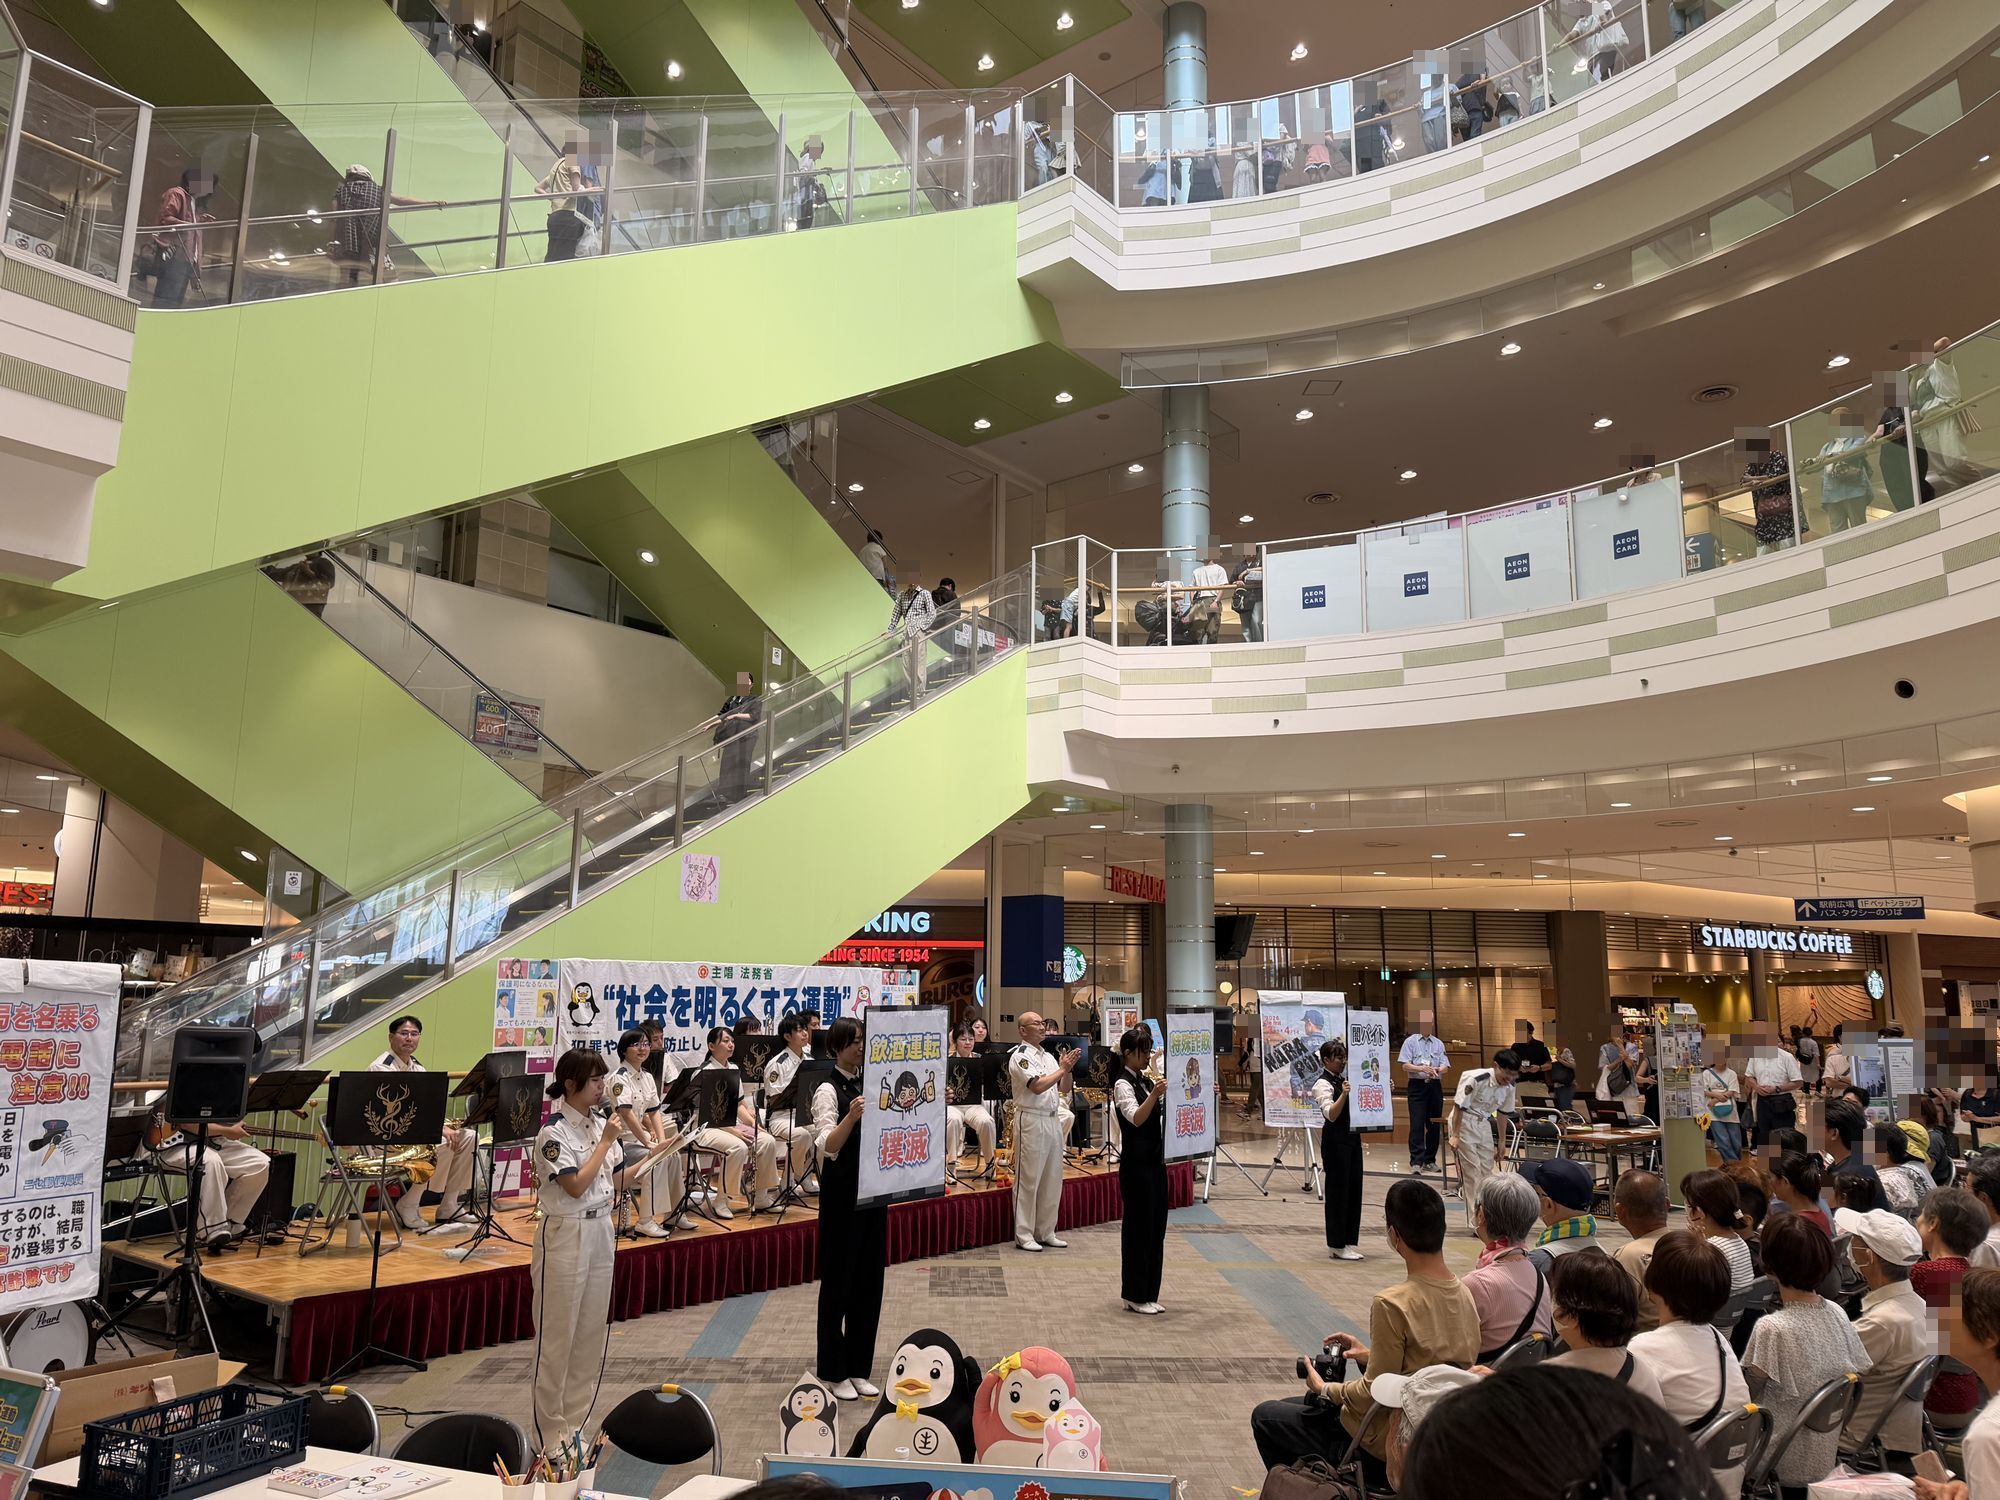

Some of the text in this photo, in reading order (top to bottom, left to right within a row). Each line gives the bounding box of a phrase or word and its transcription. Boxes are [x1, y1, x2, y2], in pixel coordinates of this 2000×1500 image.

[1615, 536, 1638, 545] AEON
[1615, 544, 1638, 554] CARD
[1507, 559, 1528, 568] AEON
[1507, 567, 1528, 576] CARD
[1304, 597, 1324, 605] CARD
[1819, 900, 1855, 909] 駅前広場
[1870, 899, 1919, 907] ペットショップ
[1701, 925, 1853, 954] STARBUCKS COFFEE
[859, 948, 895, 962] SINCE
[898, 948, 929, 962] 1954
[711, 966, 773, 981] 主唱 法務省
[1170, 1030, 1212, 1057] 特殊詐欺
[1351, 1024, 1386, 1046] 闇バイト
[869, 1032, 941, 1064] 飲酒運転
[1358, 1085, 1385, 1112] 撲滅
[1175, 1103, 1206, 1138] 撲滅
[878, 1123, 931, 1170] 撲滅
[30, 1308, 62, 1330] Pearl
